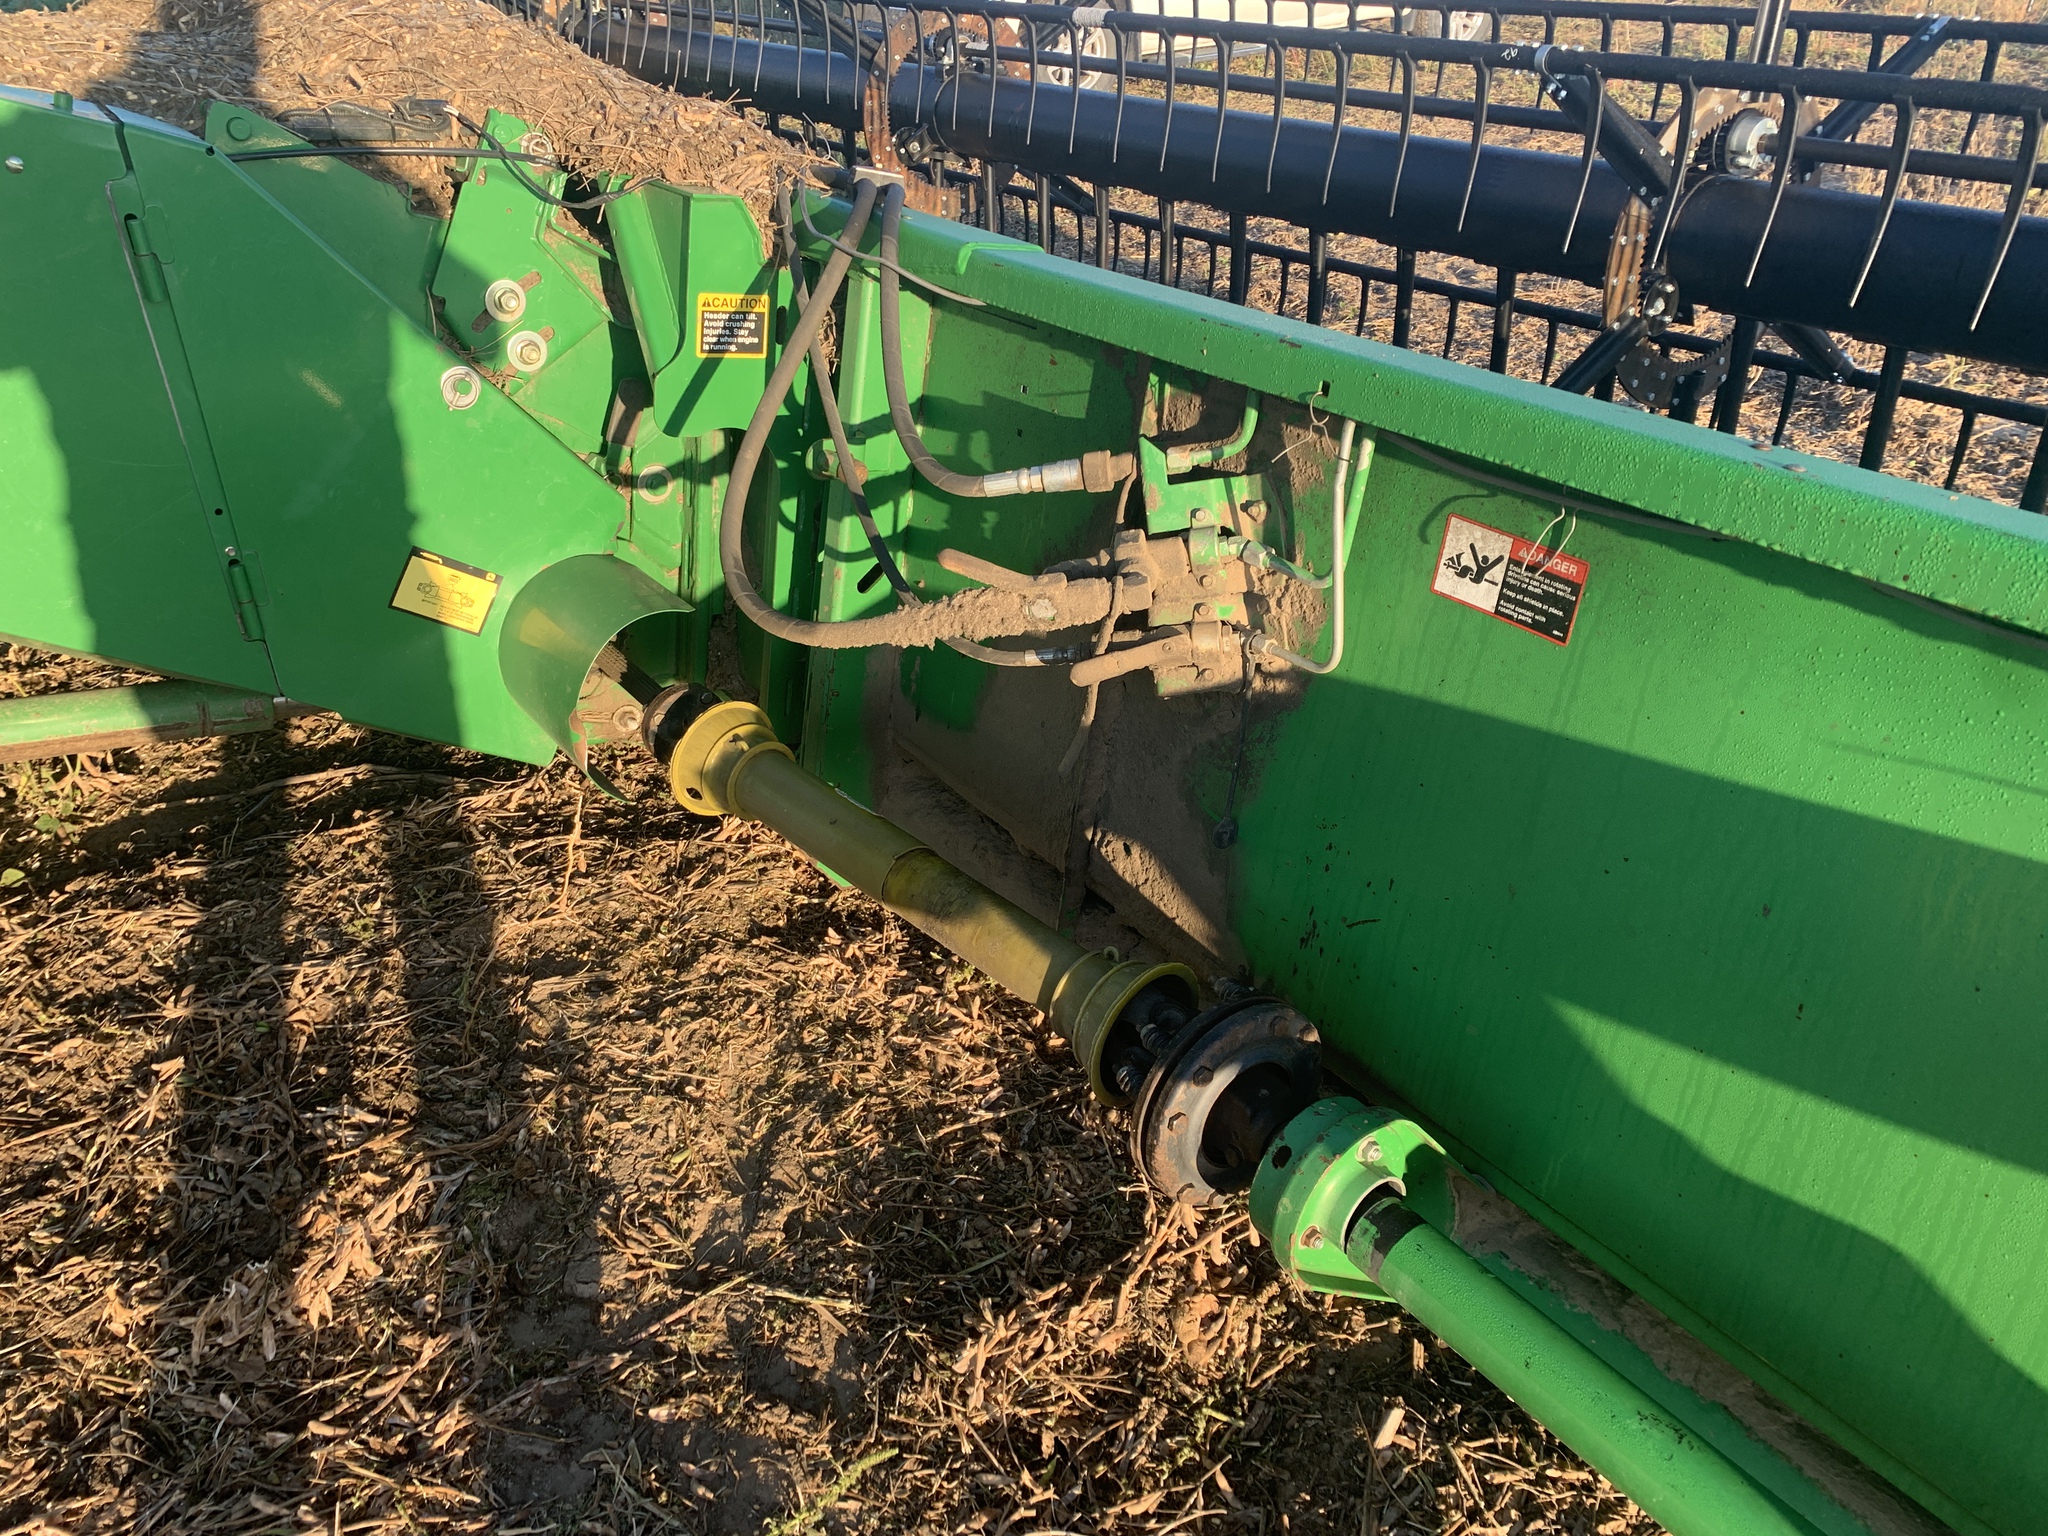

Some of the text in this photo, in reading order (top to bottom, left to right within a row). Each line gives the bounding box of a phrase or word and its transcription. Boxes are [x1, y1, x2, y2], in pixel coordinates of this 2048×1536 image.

[712, 297, 766, 309] CAUTION
[703, 328, 749, 336] injuries. Stay
[725, 320, 756, 330] crushing
[710, 344, 738, 352] running.
[1529, 549, 1578, 577] DANGER
[1506, 576, 1520, 588] injury
[1528, 584, 1544, 596] death.
[1530, 579, 1540, 587] can
[1540, 584, 1556, 594] cause
[1556, 590, 1576, 602] serious
[1550, 580, 1572, 594] rotating
[1500, 600, 1546, 622] Avoid contact with
[1502, 588, 1516, 598] Keep
[1524, 596, 1542, 608] shields
[1548, 604, 1564, 617] place.
[1498, 606, 1533, 624] rotating parts.
